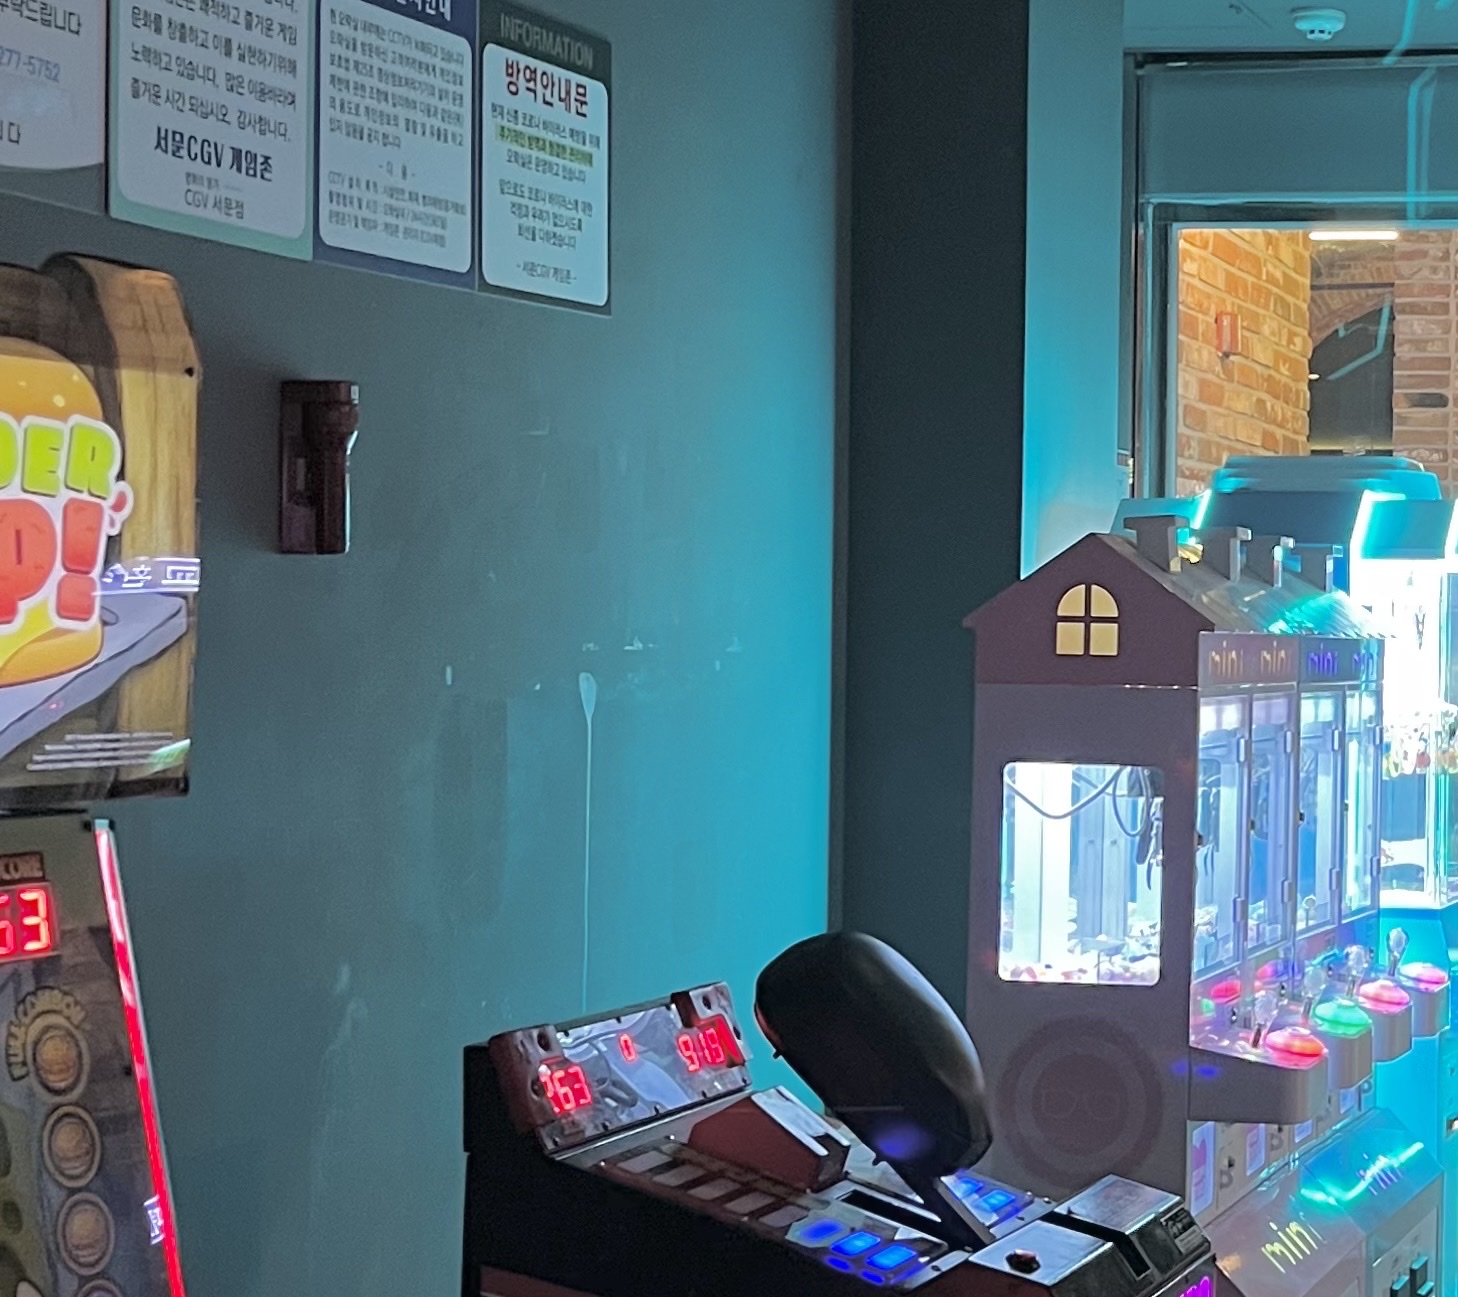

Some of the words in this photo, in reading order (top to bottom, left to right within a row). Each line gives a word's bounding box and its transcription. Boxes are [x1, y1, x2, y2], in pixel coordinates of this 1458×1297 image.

[501, 13, 595, 70] INFORMATION
[505, 57, 589, 118] 방역안내문
[154, 125, 224, 168] 서문CGV
[229, 146, 273, 182] 게임존
